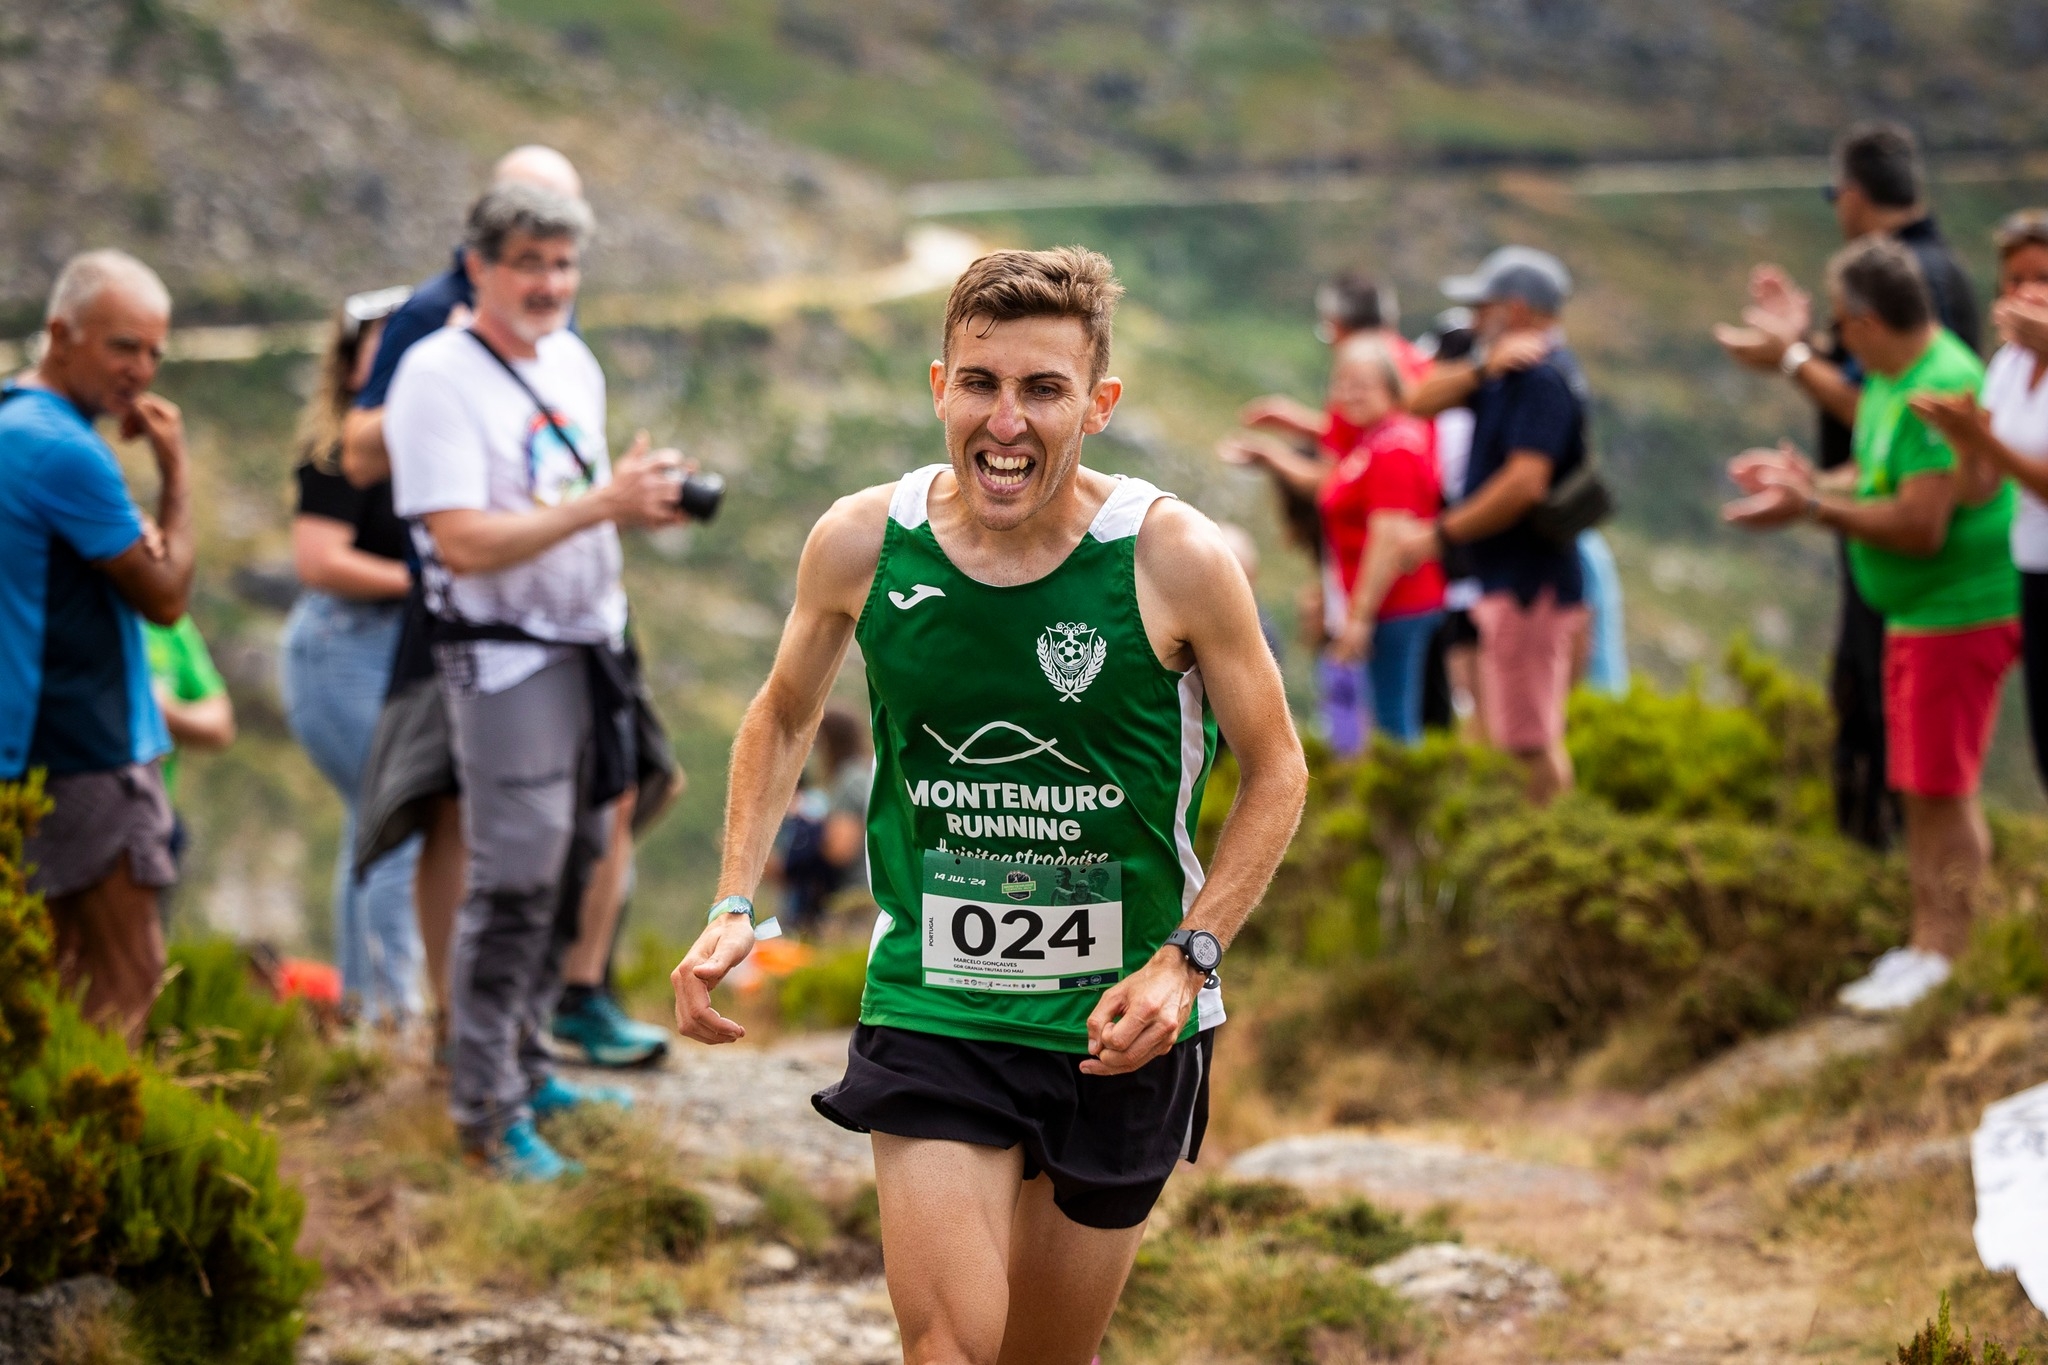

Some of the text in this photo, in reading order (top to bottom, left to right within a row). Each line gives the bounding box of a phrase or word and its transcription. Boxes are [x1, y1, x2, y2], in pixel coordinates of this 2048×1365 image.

[905, 778, 1125, 812] MONTEMURO
[946, 812, 1081, 841] RUNNING
[934, 872, 946, 880] 14
[947, 875, 966, 884] JUL
[951, 904, 1096, 960] 024
[953, 957, 1018, 968] MARCELO GONÇALVES
